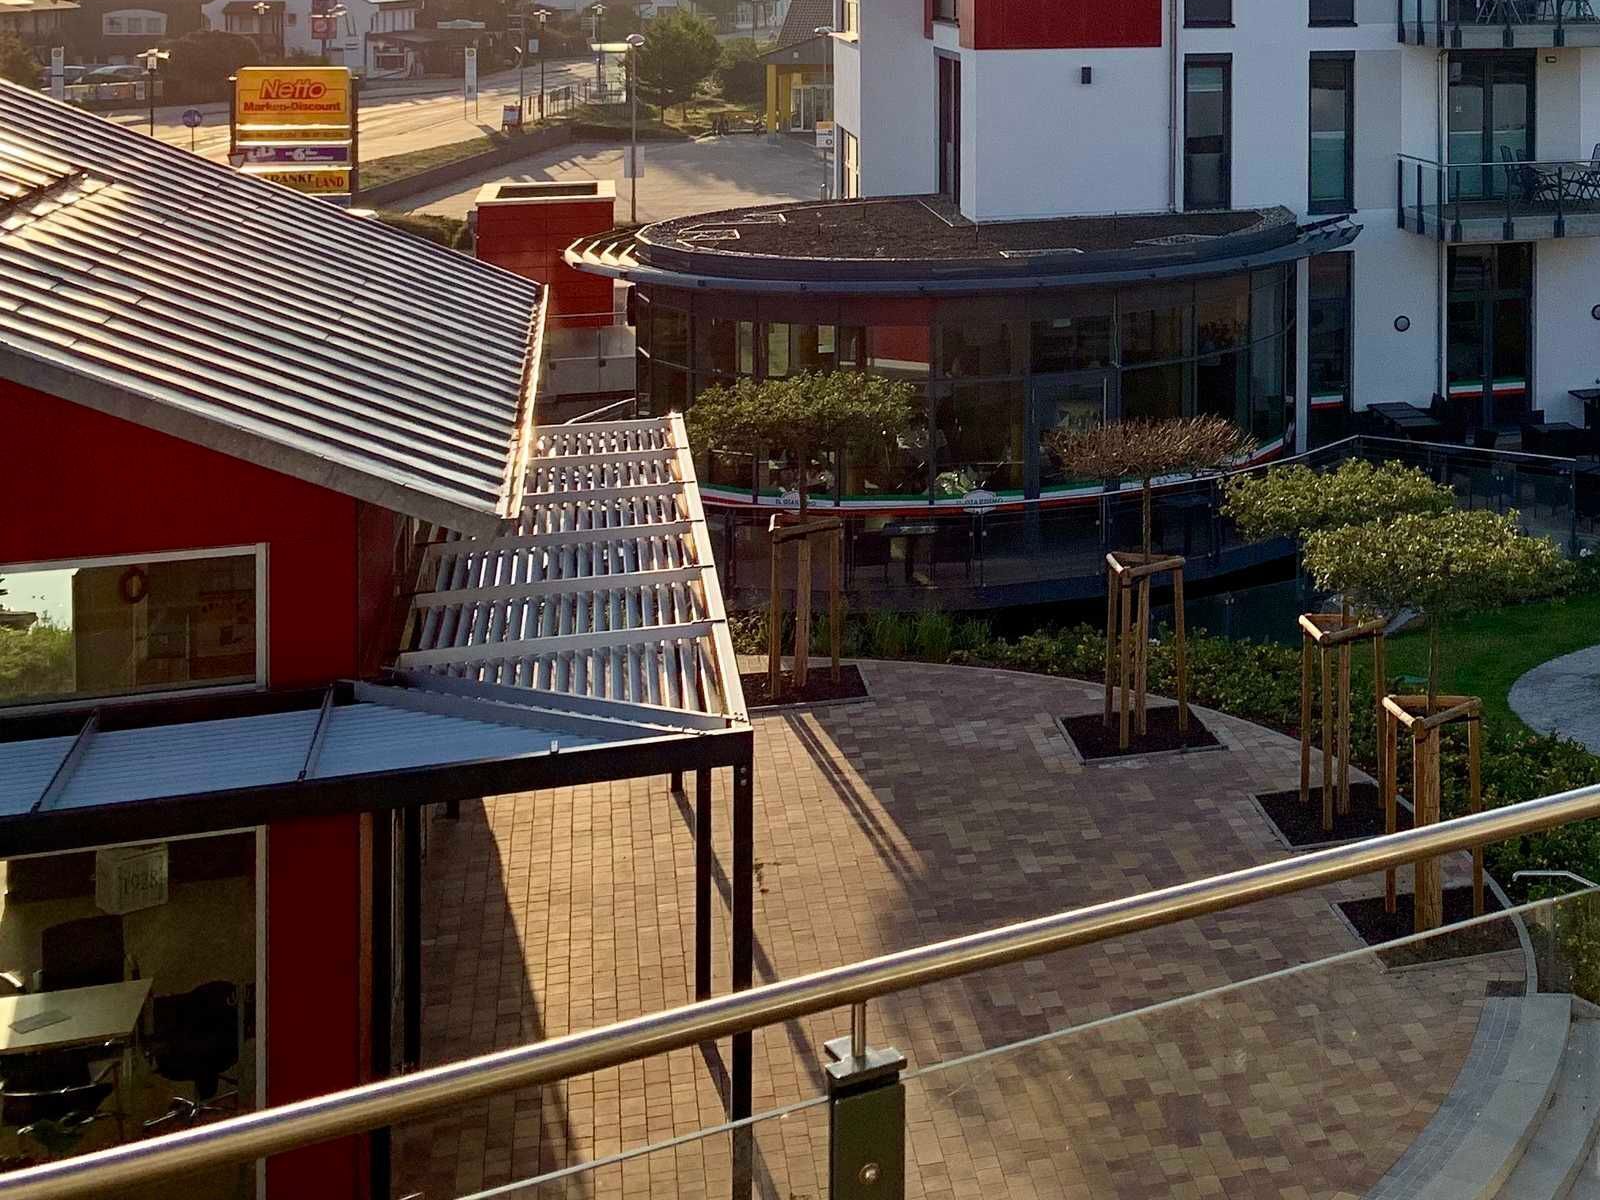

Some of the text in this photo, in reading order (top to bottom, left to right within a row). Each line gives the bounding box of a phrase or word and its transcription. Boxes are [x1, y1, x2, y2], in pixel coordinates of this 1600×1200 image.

[260, 79, 326, 99] Netto
[243, 101, 341, 112] Marken-Discount
[315, 176, 344, 188] LAND
